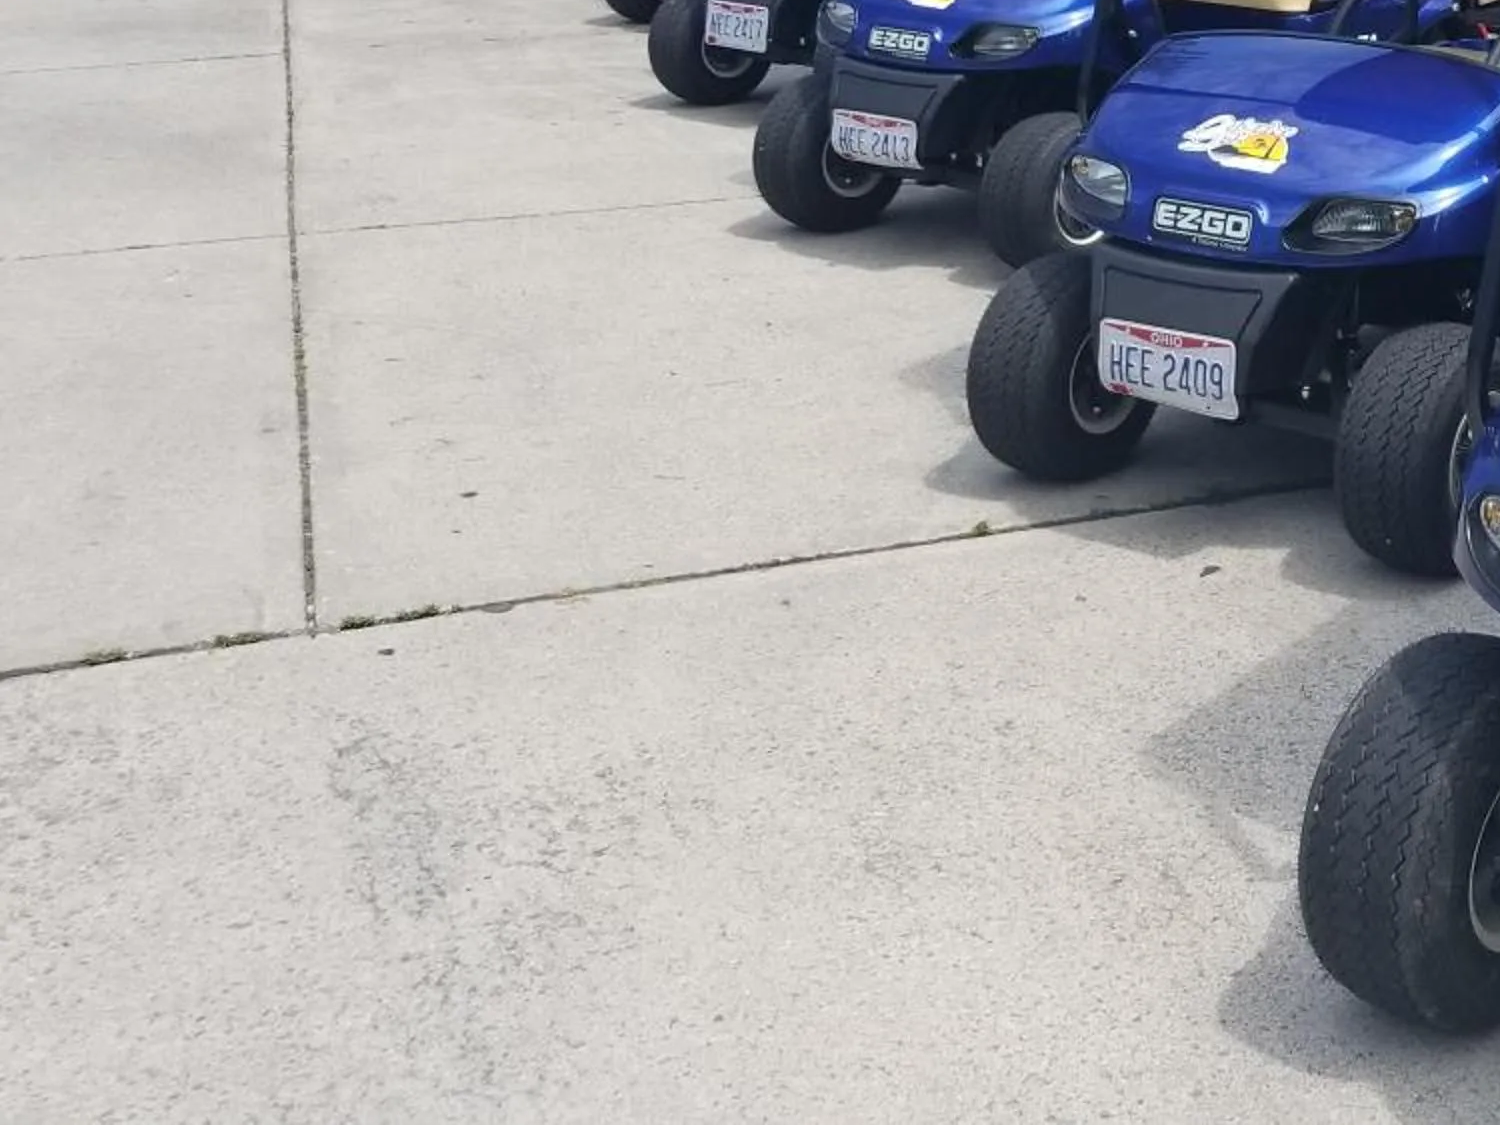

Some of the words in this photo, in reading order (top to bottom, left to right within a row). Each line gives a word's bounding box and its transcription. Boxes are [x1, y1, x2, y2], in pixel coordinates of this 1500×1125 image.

[839, 126, 867, 156] HEE
[1151, 332, 1183, 348] OHIO
[1110, 343, 1155, 388] HEE
[1163, 354, 1223, 400] 2409
